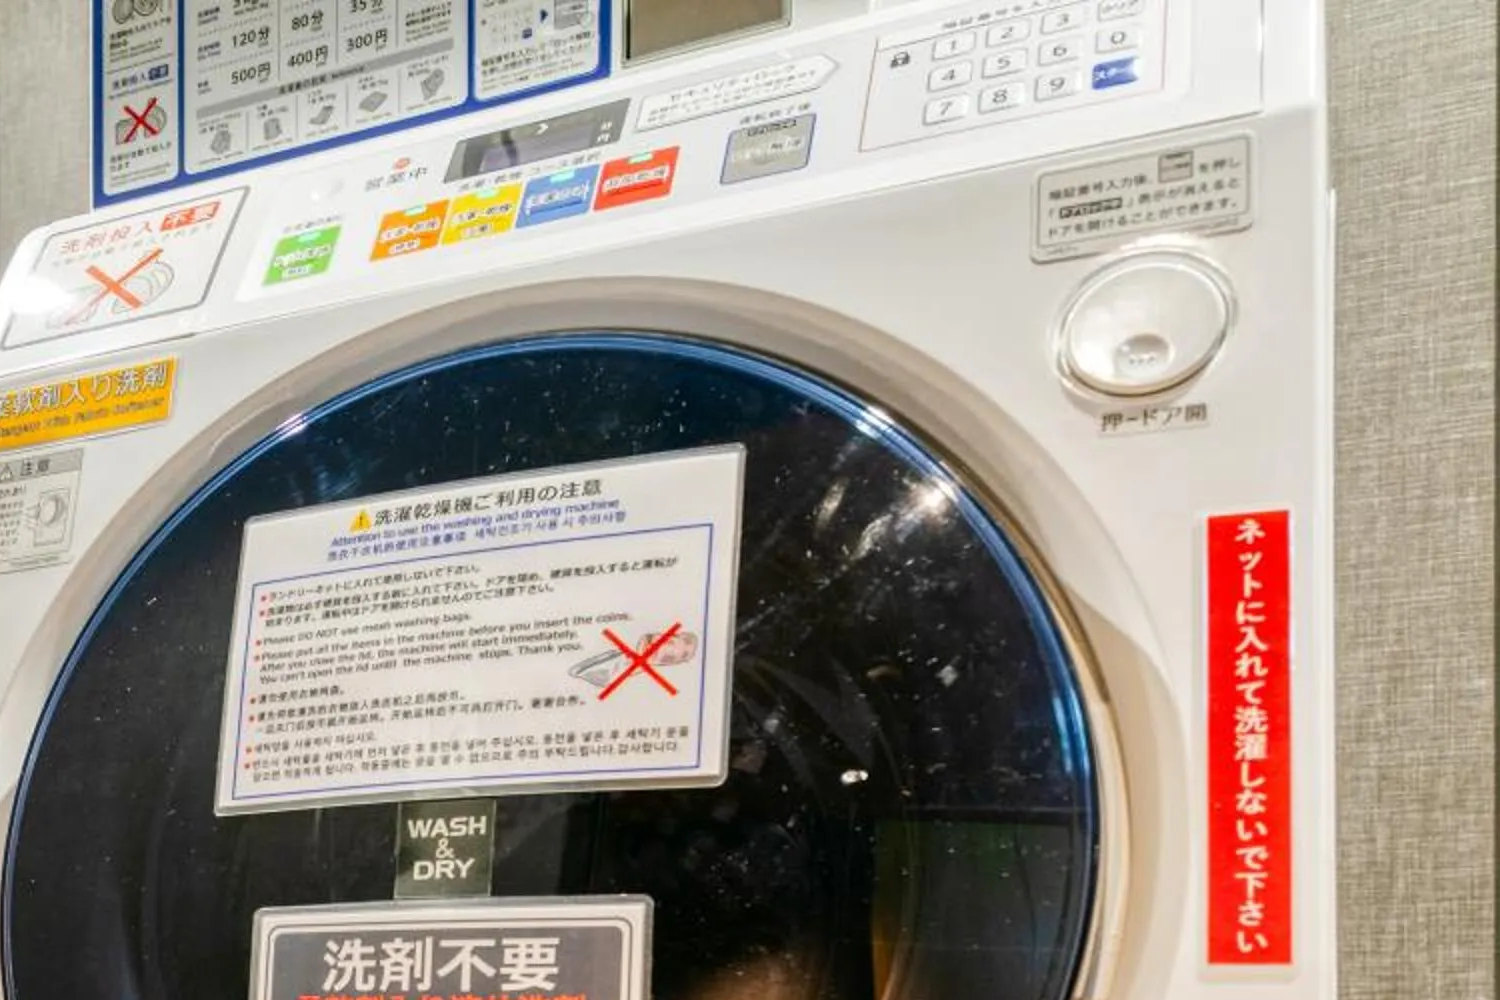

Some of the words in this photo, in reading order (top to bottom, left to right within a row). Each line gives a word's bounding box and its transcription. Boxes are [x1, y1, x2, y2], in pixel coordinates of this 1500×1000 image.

[232, 27, 269, 47] 120分
[287, 45, 328, 67] 400円
[231, 62, 271, 85] 500円
[374, 478, 603, 526] 洗濯乾燥機ご利用の注意
[331, 530, 380, 547] Attention
[472, 636, 498, 648] start
[518, 642, 554, 655] Thank
[1235, 520, 1268, 953] ネットに入れて洗濯しないで下さい
[407, 815, 487, 837] WASH
[435, 839, 455, 858] &
[412, 858, 475, 881] DRY
[321, 936, 560, 992] 洗剤不要
